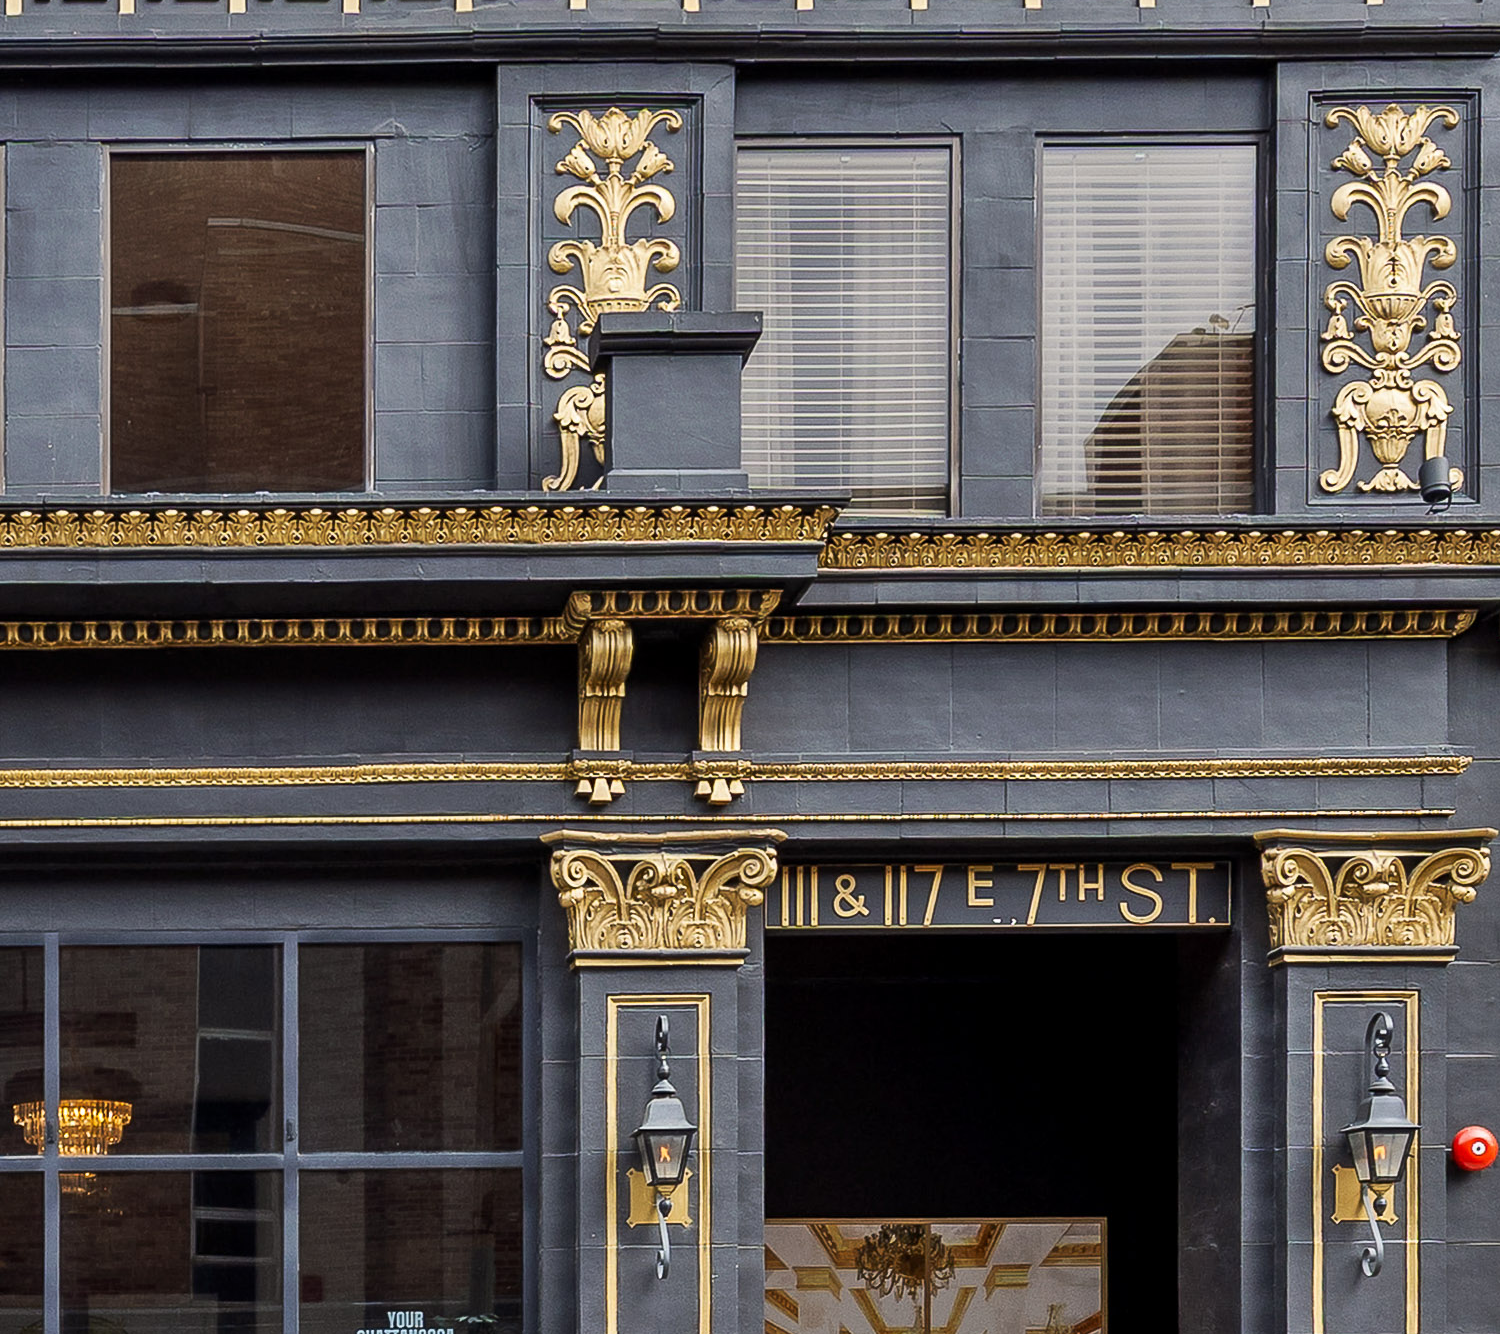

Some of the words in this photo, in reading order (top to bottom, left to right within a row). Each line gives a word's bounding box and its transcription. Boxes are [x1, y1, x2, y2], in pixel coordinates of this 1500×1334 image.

[781, 865, 819, 927] 111
[833, 873, 870, 918] &
[884, 864, 944, 928] 117
[967, 865, 995, 907] E
[1017, 863, 1105, 926] 7TH
[387, 1311, 424, 1329] YOUR
